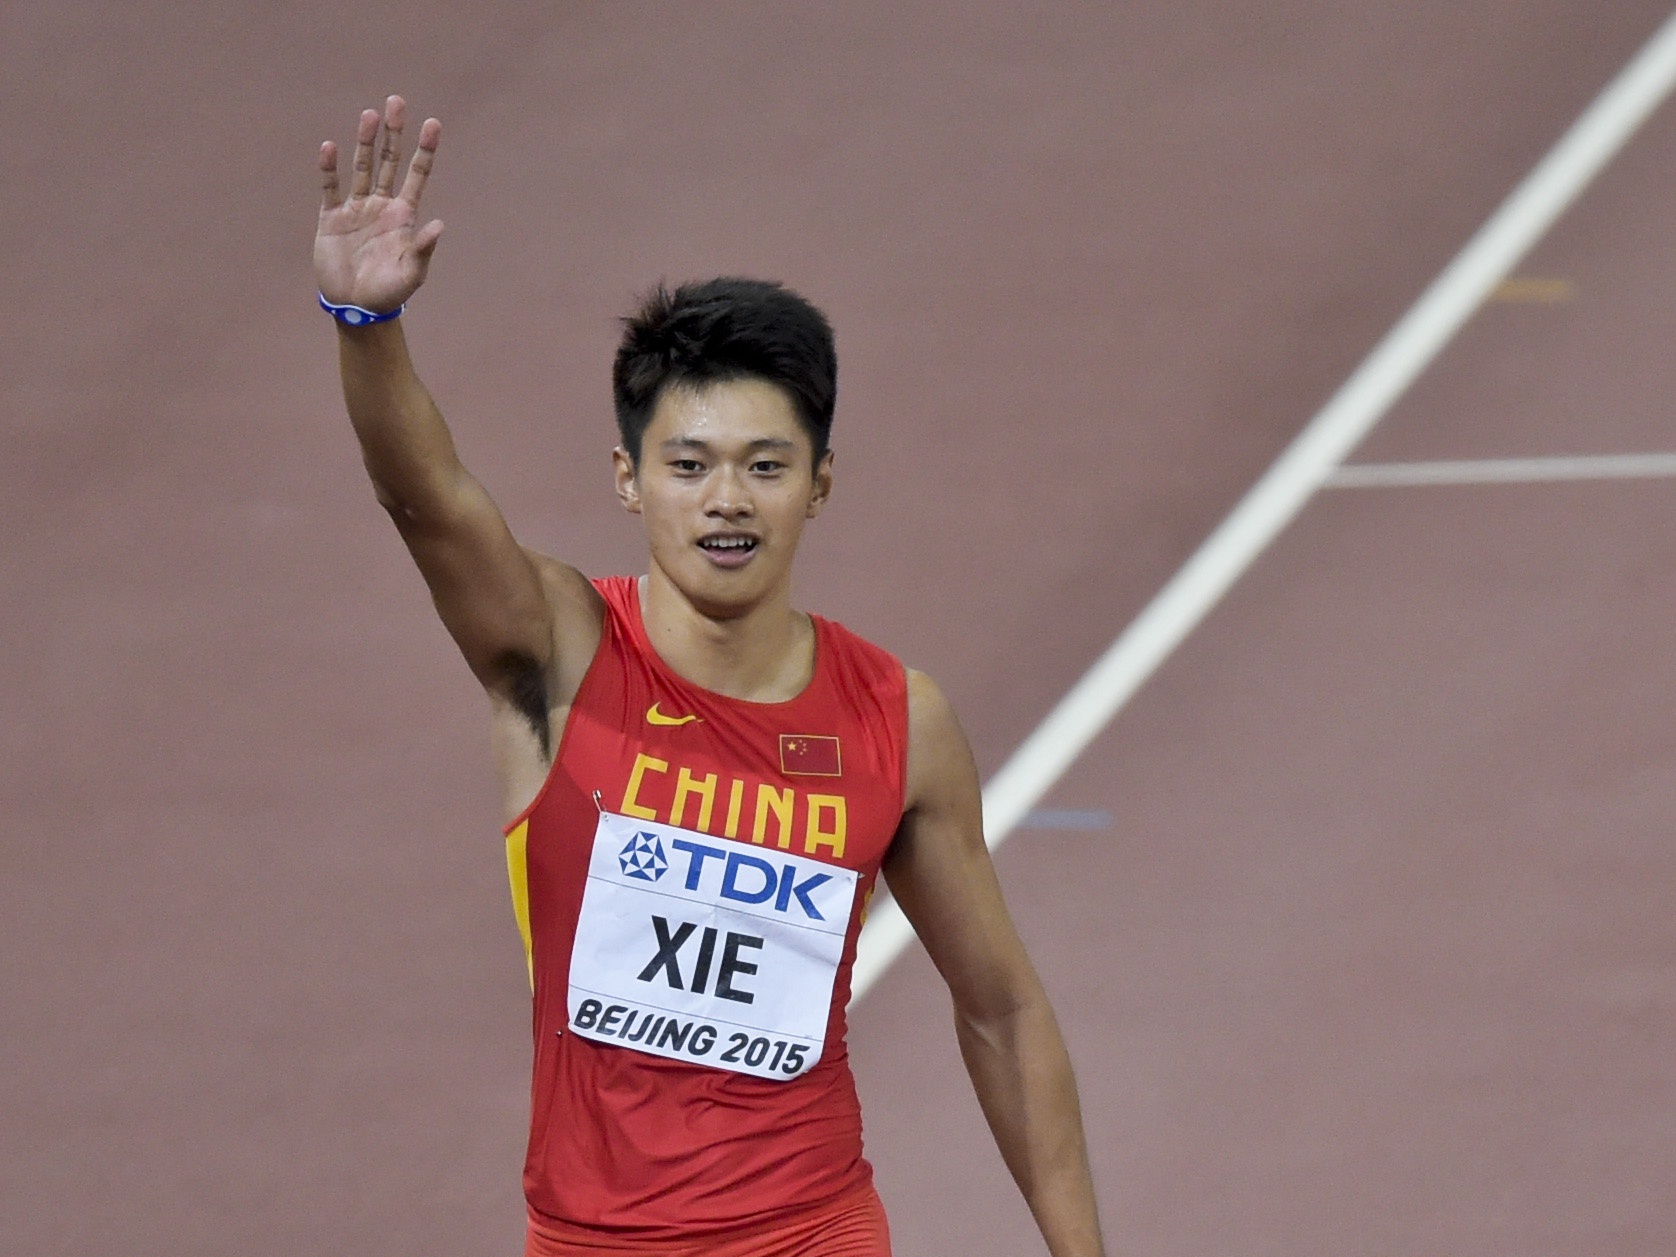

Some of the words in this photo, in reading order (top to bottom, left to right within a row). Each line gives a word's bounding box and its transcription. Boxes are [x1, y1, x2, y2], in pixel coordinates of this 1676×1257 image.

[620, 753, 847, 858] CHINA
[672, 838, 833, 921] TDK
[636, 915, 764, 1004] XIE
[574, 998, 717, 1056] BEIJING
[720, 1032, 810, 1074] 2015
